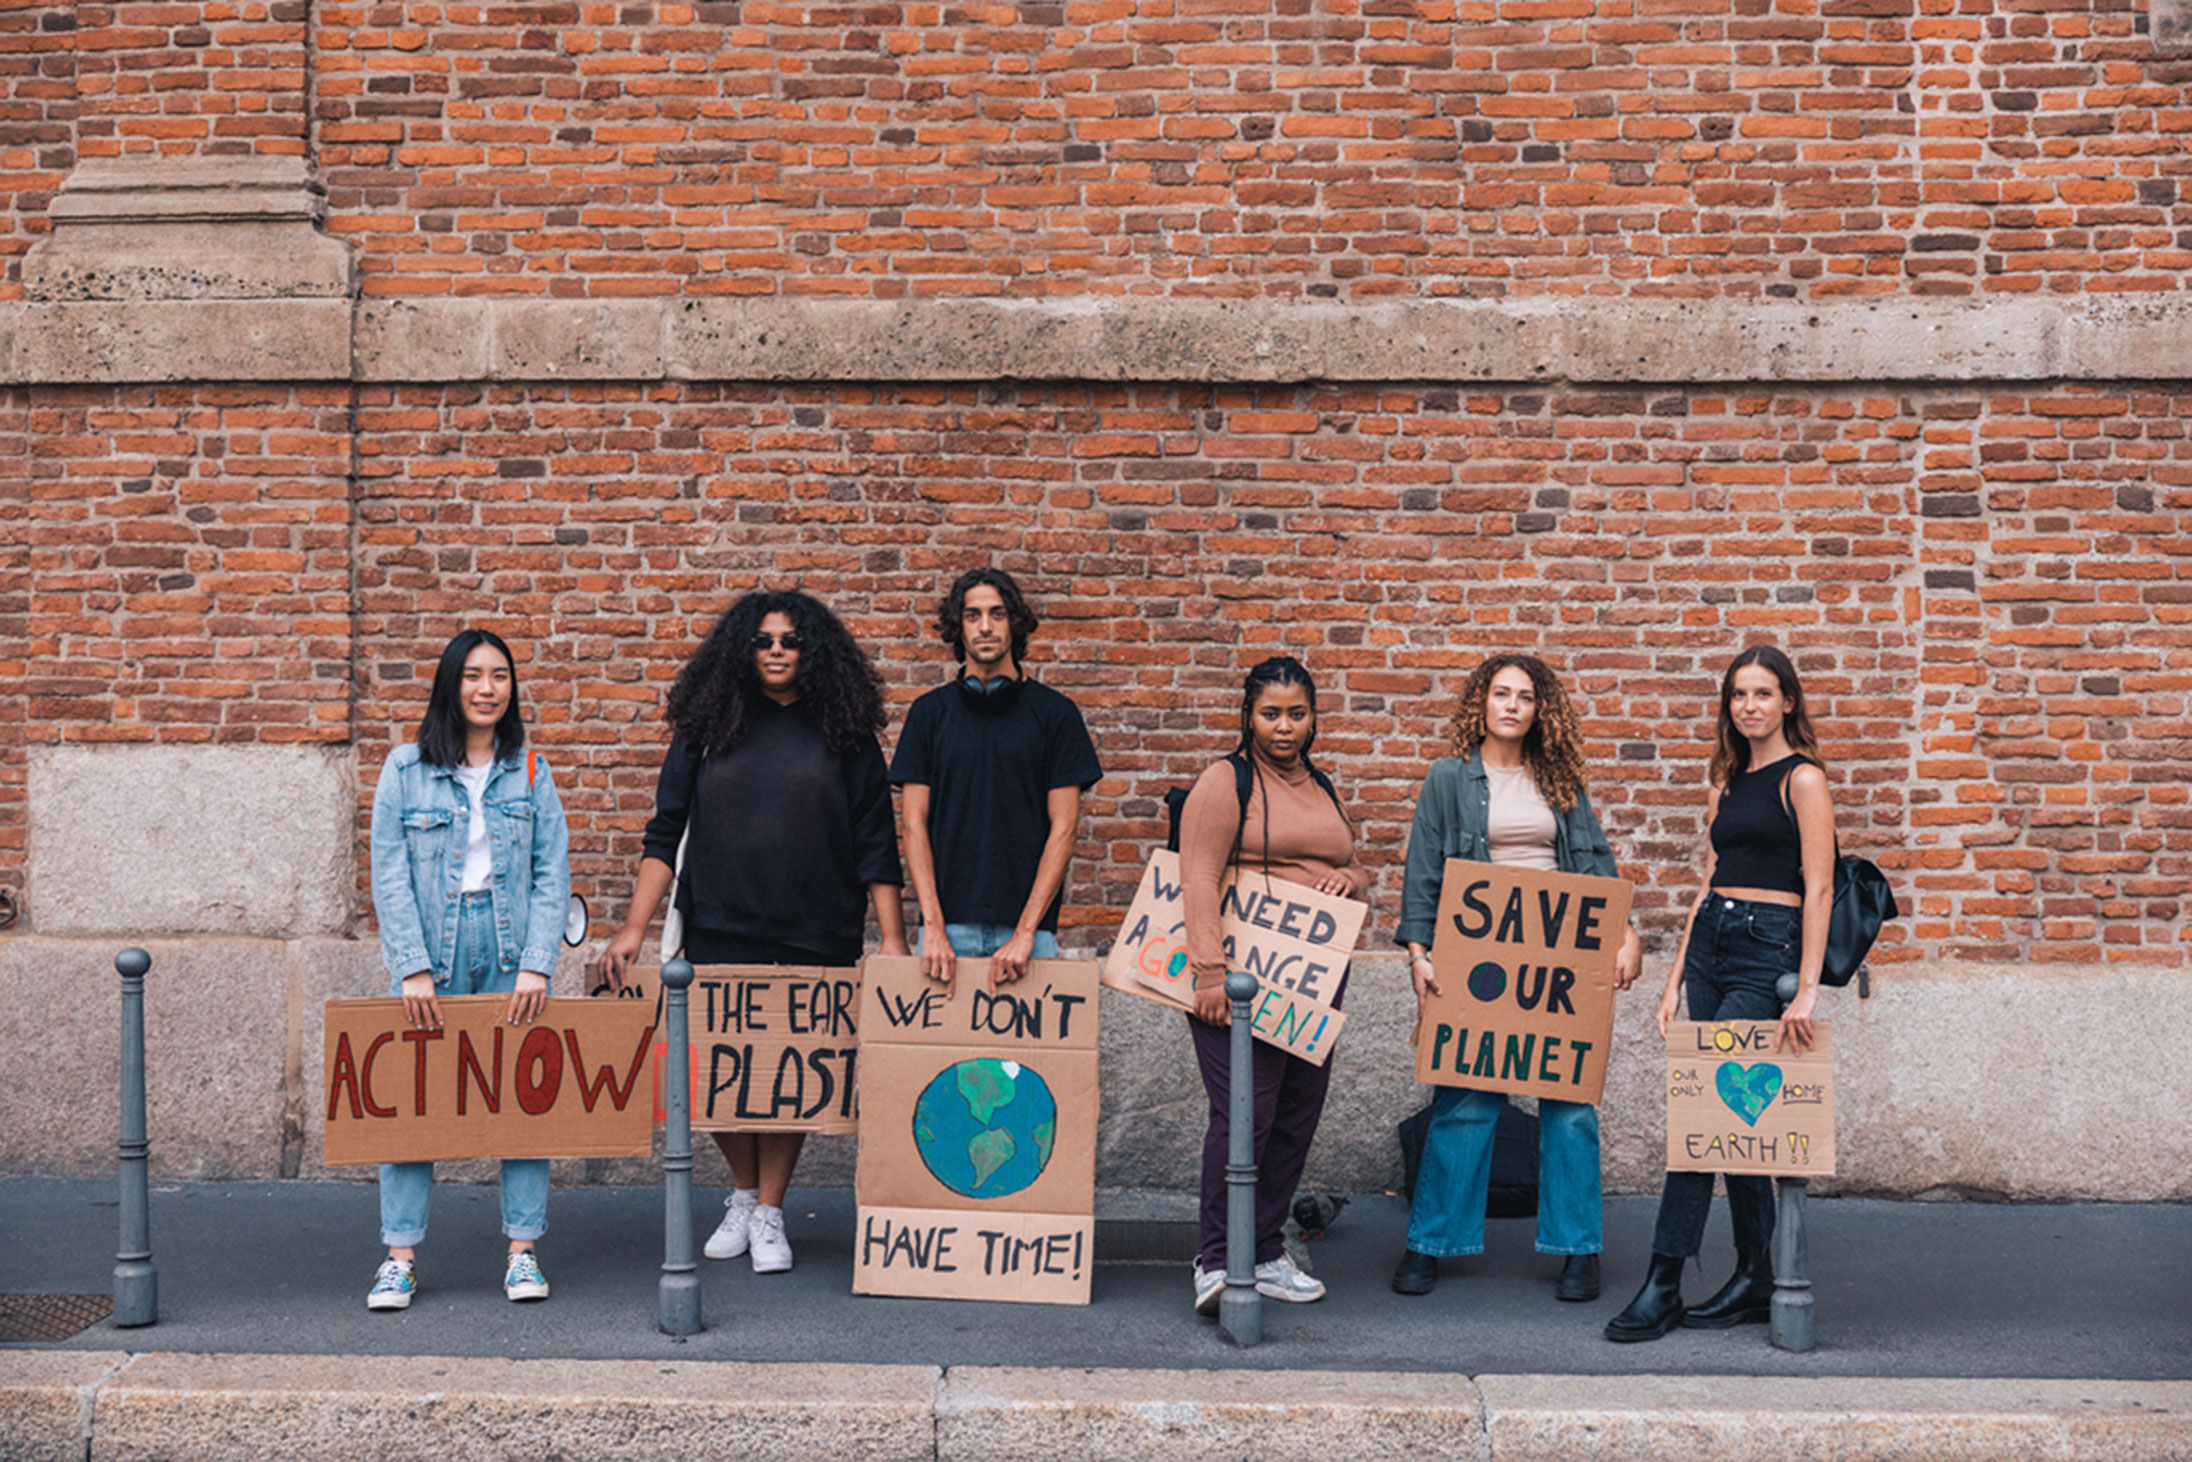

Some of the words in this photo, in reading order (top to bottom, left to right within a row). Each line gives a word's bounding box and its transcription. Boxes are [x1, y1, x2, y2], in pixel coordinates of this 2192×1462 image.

[1220, 885, 1337, 945] NEED
[1453, 880, 1607, 950] SAVE
[1138, 936, 1191, 982] GO
[699, 981, 770, 1033] THE
[788, 980, 860, 1037] EAR
[876, 985, 948, 1029] WE
[971, 983, 1087, 1040] DON'T
[1467, 961, 1576, 1015] OUR
[1431, 1023, 1593, 1085] PLANET
[1697, 1025, 1775, 1053] LOVE
[328, 1029, 444, 1120] ACT
[457, 1026, 653, 1116] NOW
[706, 1043, 860, 1120] PLAST
[1670, 1085, 1704, 1097] ONLY
[1783, 1084, 1825, 1100] HOME
[1673, 1069, 1699, 1081] OUR
[863, 1216, 958, 1272] HAVE
[977, 1230, 1083, 1281] TIME!
